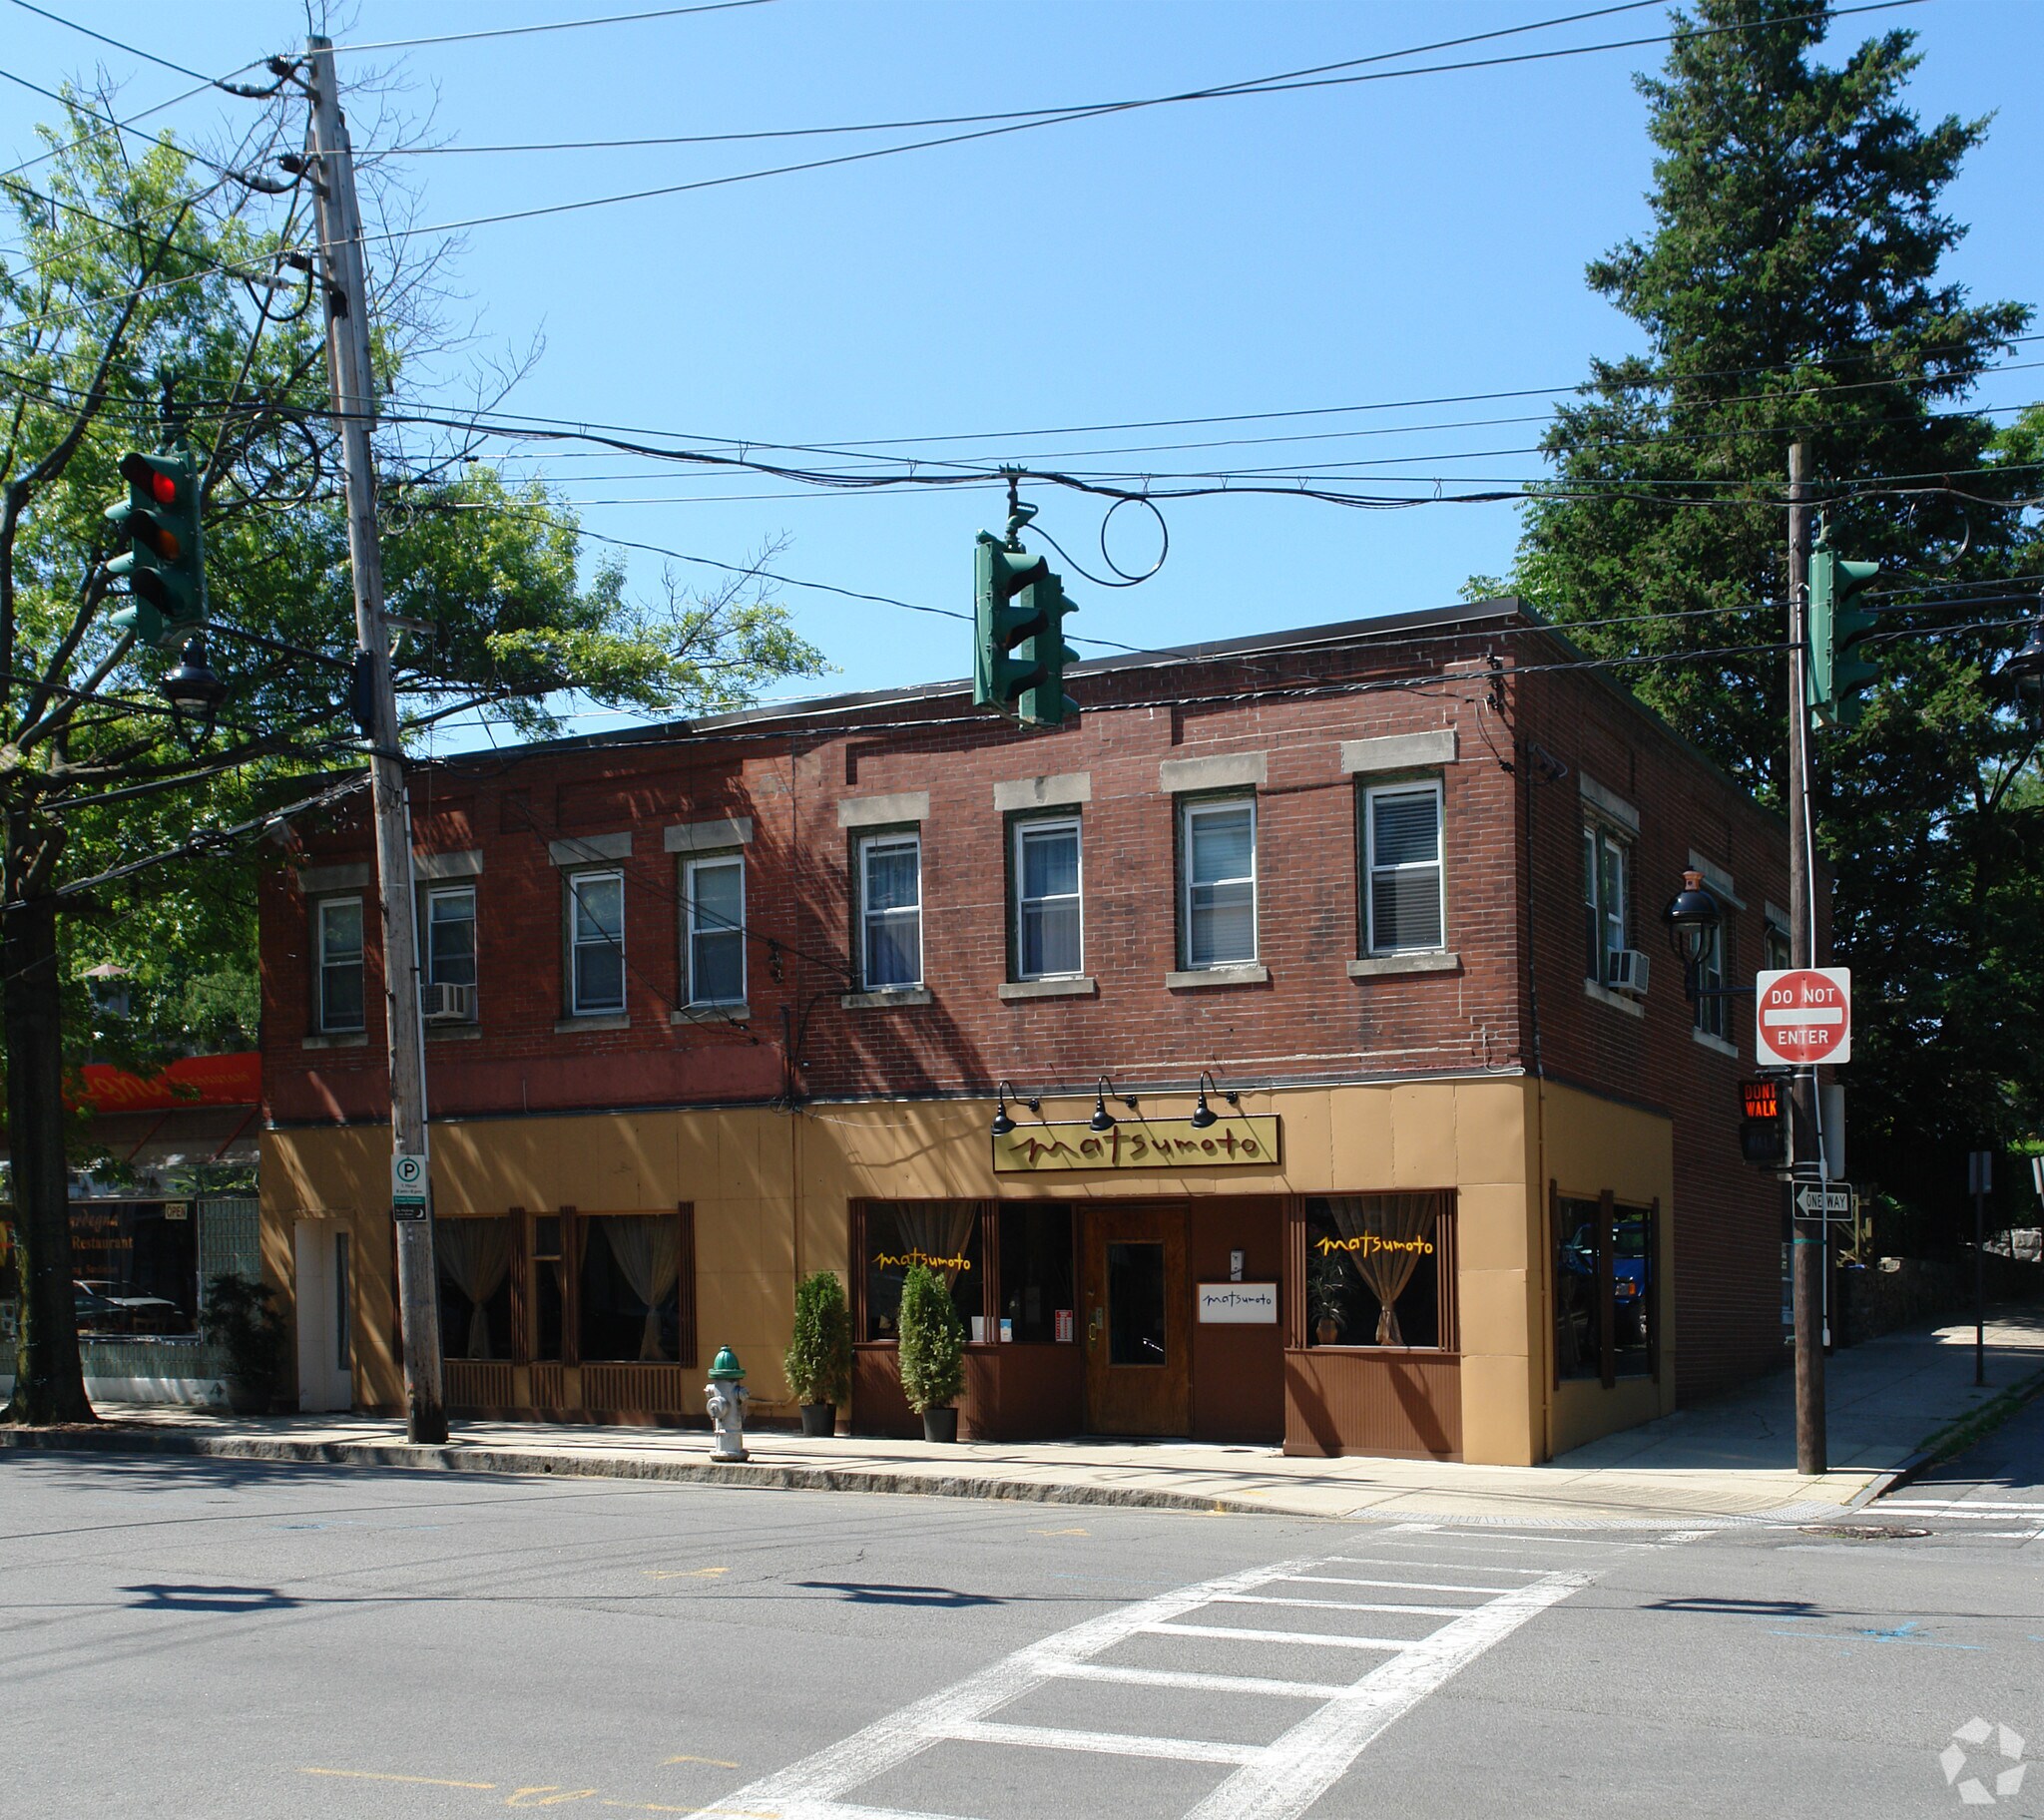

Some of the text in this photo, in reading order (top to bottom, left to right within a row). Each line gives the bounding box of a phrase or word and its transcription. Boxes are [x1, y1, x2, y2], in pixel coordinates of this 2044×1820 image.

[1772, 988, 1835, 1005] DO NOT
[1778, 1030, 1829, 1046] ENTER
[1745, 1083, 1777, 1100] DONT
[1746, 1100, 1778, 1117] WALK
[1007, 1125, 1258, 1164] matsumoto
[404, 1163, 415, 1177] P
[1806, 1193, 1846, 1208] ONE WAY
[166, 1204, 187, 1217] OPEN
[72, 1236, 134, 1249] Restaurant
[1313, 1229, 1434, 1258] matsumoto
[871, 1246, 971, 1271] matsumoto
[1203, 1290, 1273, 1307] matsumoto
